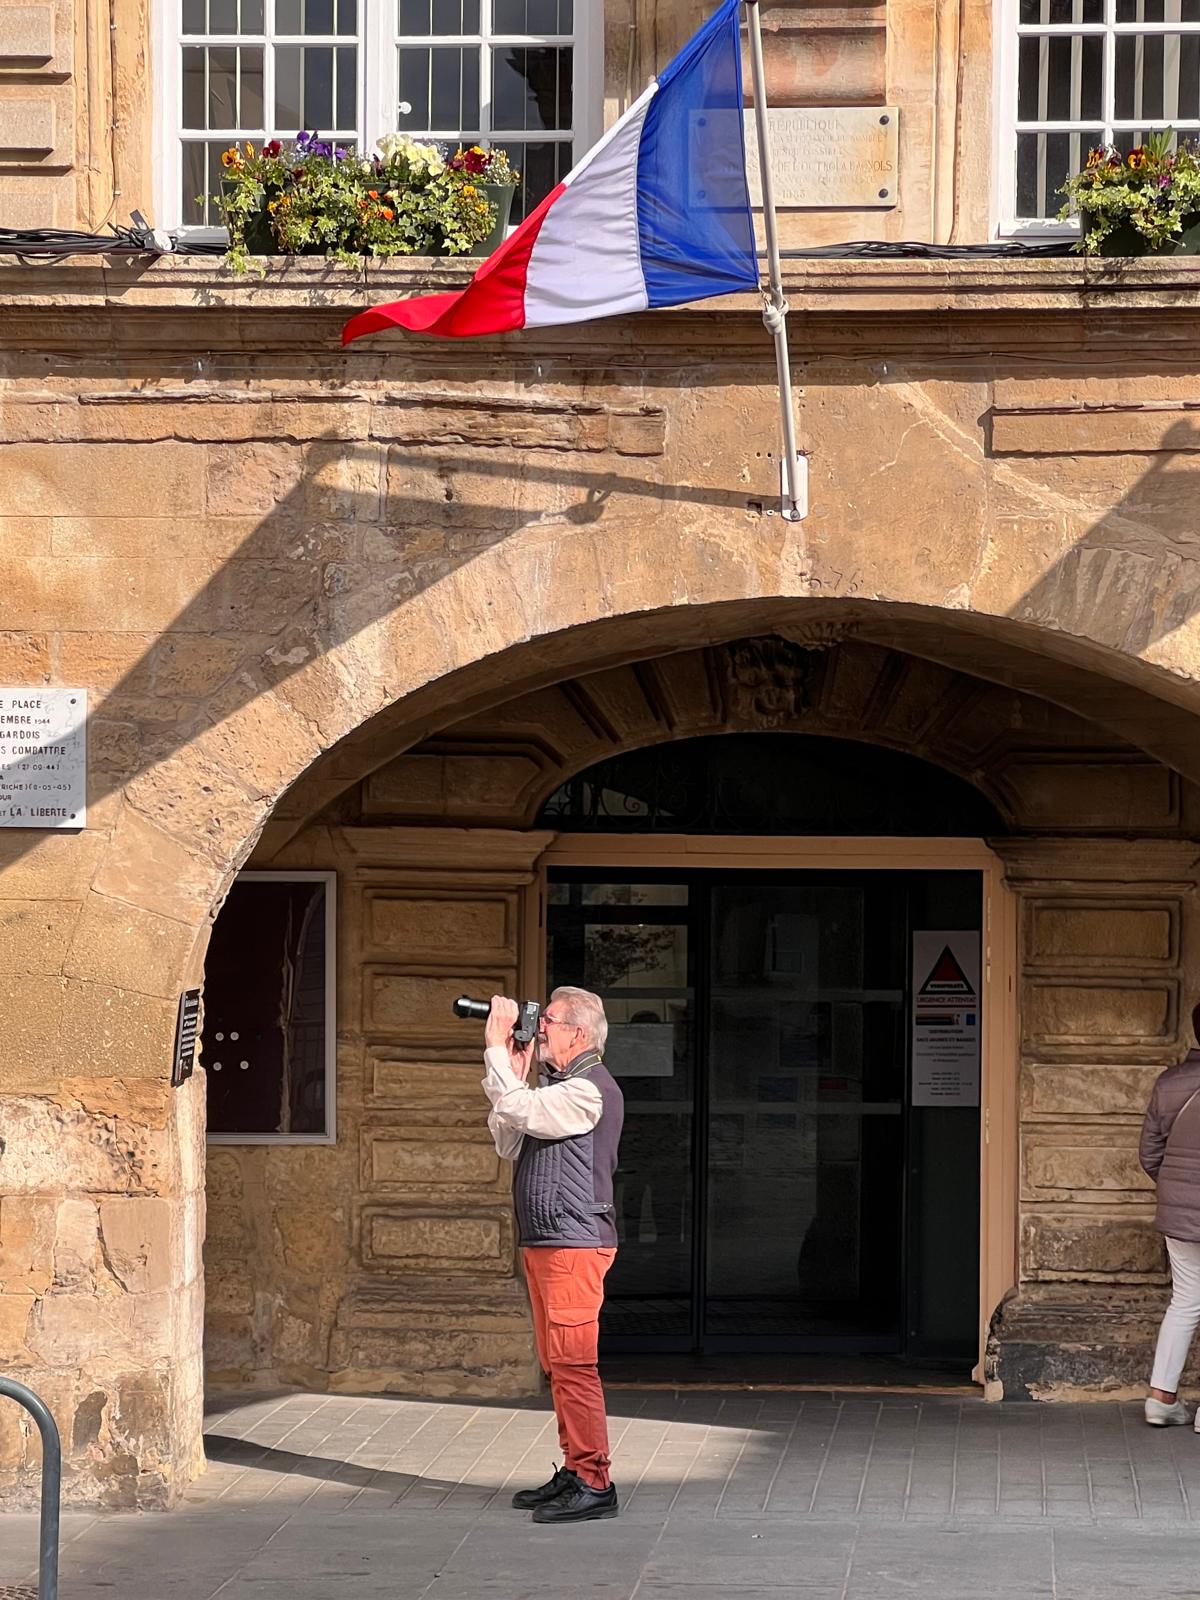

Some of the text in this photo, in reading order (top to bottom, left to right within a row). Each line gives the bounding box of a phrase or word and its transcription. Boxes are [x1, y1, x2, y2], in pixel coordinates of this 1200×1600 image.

[12, 700, 42, 709] PLACE
[12, 746, 66, 755] COMBATTRE
[10, 807, 22, 817] LA
[30, 807, 67, 817] LIBERTE
